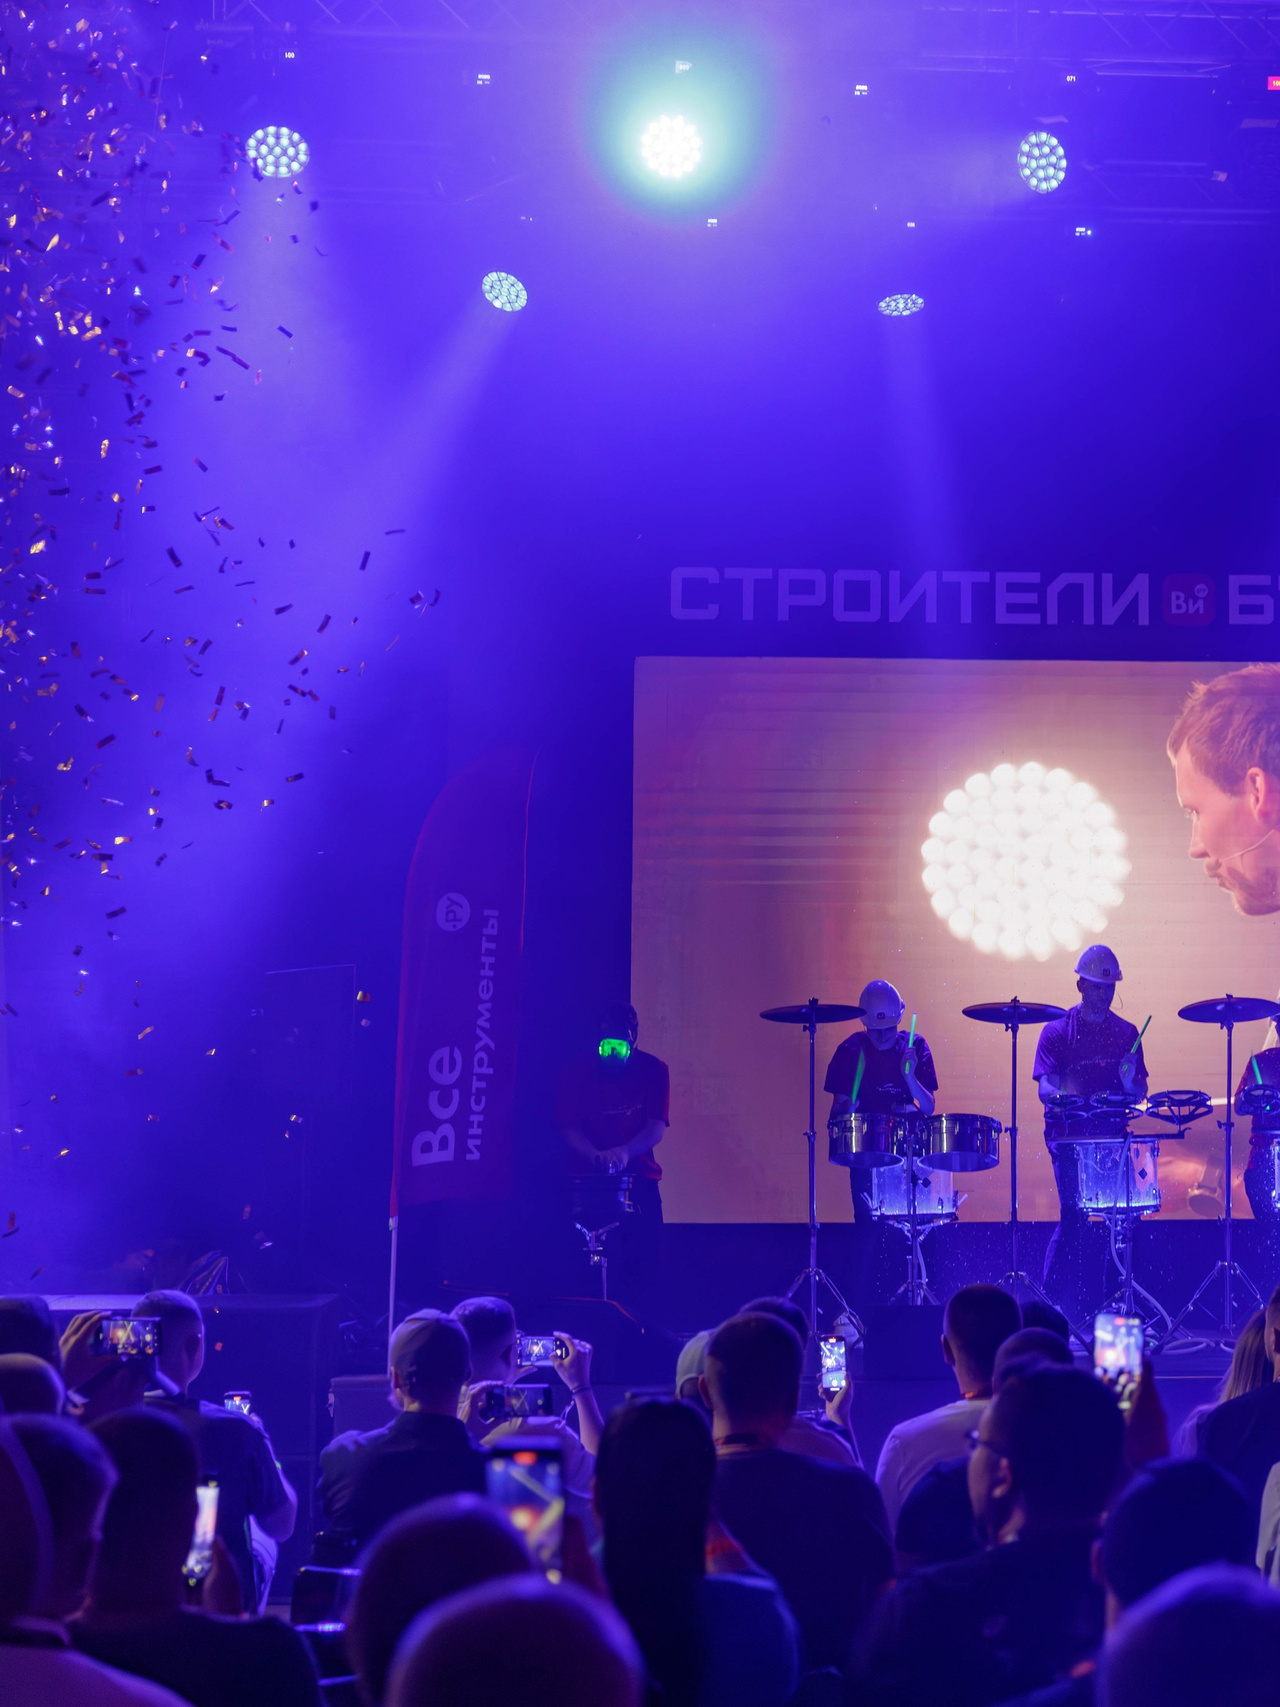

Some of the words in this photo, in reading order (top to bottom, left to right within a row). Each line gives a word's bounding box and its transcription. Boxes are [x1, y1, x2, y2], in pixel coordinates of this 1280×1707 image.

[671, 566, 1150, 626] СТРОИТЕЛИ
[465, 908, 500, 1161] инструменты
[411, 1045, 463, 1168] Все
